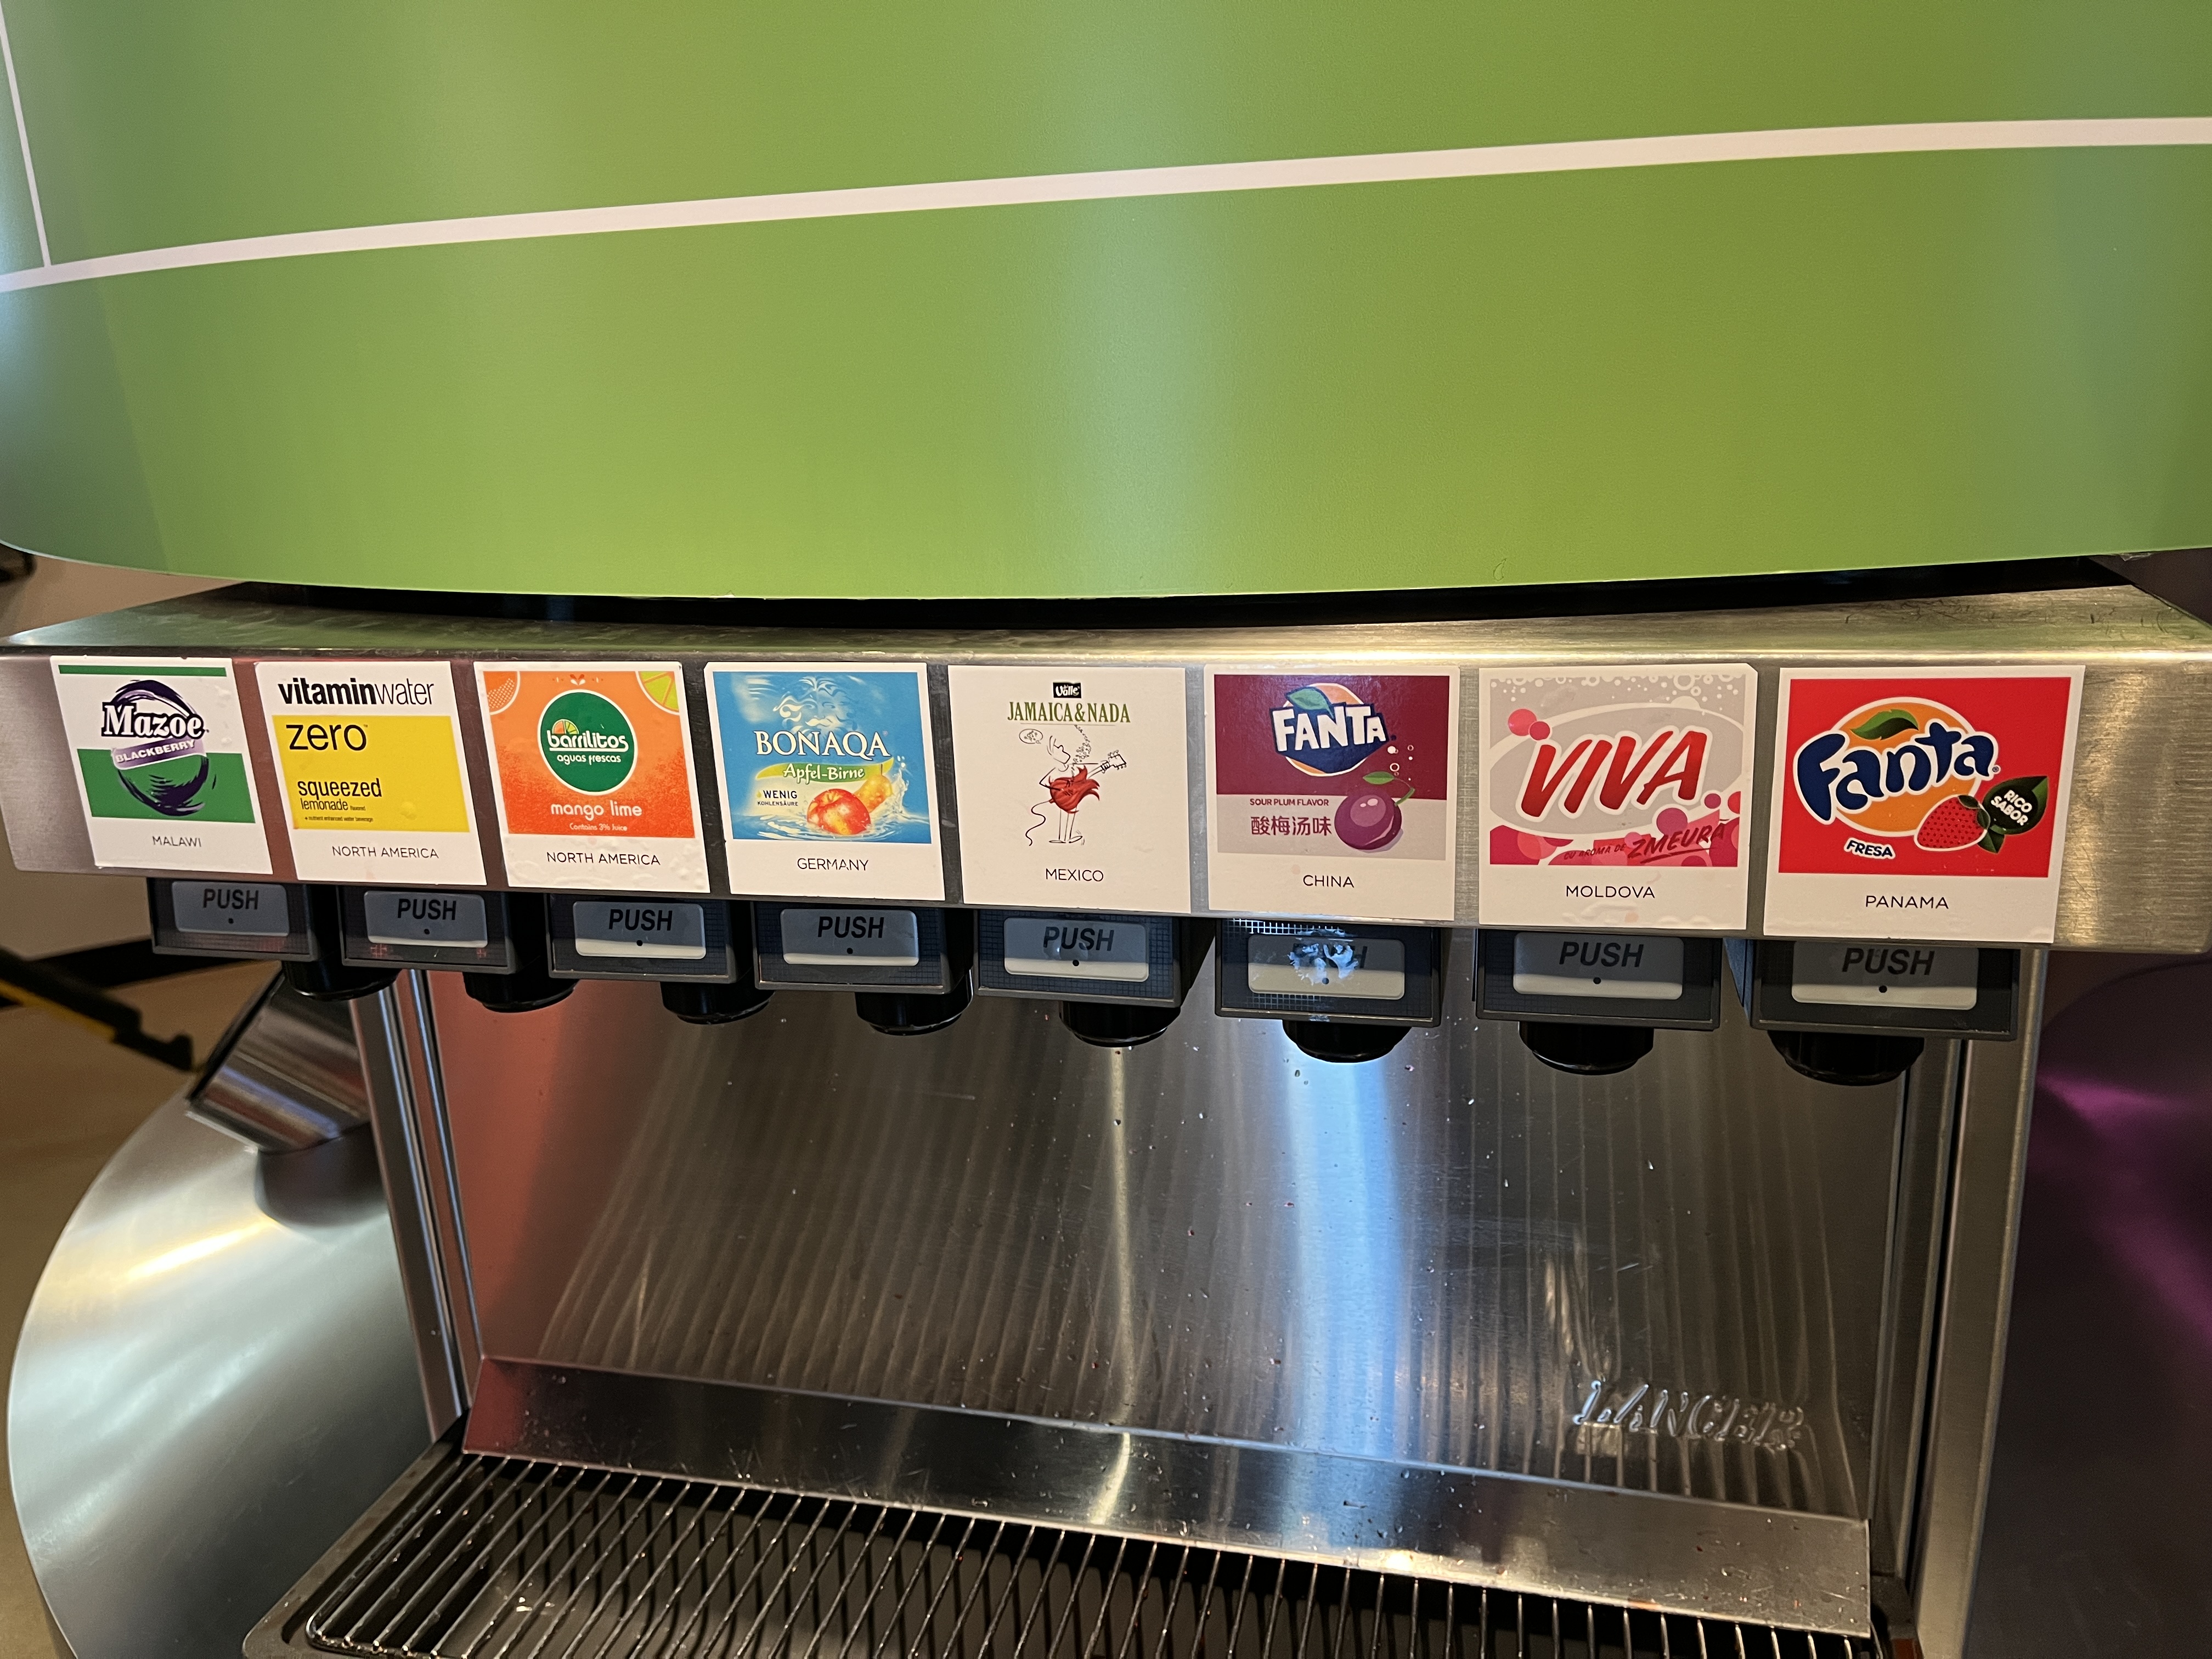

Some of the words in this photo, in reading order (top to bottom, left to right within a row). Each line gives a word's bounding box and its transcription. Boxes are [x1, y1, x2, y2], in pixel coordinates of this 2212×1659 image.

[278, 678, 435, 705] vitaminwater
[102, 702, 204, 738] Mazoe
[1271, 704, 1387, 752] FANTA
[285, 724, 367, 751] zero
[547, 730, 629, 752] barrilitos
[753, 730, 891, 760] BONAQA
[115, 740, 195, 763] BLACKBERRY
[557, 754, 586, 765] aguas
[589, 754, 621, 765] frescas
[783, 763, 865, 785] Apfel-Birne
[1521, 730, 1708, 817] VIVA
[1796, 721, 1995, 822] Fanta
[297, 777, 382, 800] squeezed
[763, 790, 798, 799] WENIG
[300, 798, 348, 810] lemonade
[551, 803, 604, 821] mango
[610, 800, 642, 816] lime
[1273, 798, 1295, 806] PLUM
[1297, 798, 1329, 806] FLAVOR
[1990, 795, 2029, 826] SABOR
[2004, 789, 2033, 813] RICO
[569, 822, 597, 831] Contains
[1251, 815, 1333, 836] 酸梅汤味
[152, 836, 202, 848] MALAWI
[332, 846, 376, 857] NORTH
[381, 847, 439, 859] AMERICA
[1847, 839, 1894, 858] FRESA
[546, 851, 593, 864] NORTH
[599, 853, 661, 865] AMERICA
[797, 858, 868, 871] GERMANY
[1045, 868, 1104, 882] MEXICO
[1302, 874, 1355, 888] CHINA
[202, 888, 259, 910] PUSH
[1566, 885, 1655, 899] MOLDOVA
[1866, 895, 1949, 909] PANAMA
[397, 898, 457, 921] PUSH
[608, 909, 673, 932] PUSH
[817, 916, 885, 939] PUSH
[1043, 926, 1115, 952] PUSH
[1558, 940, 1644, 968] PUSH
[1842, 947, 1935, 976] PUSH
